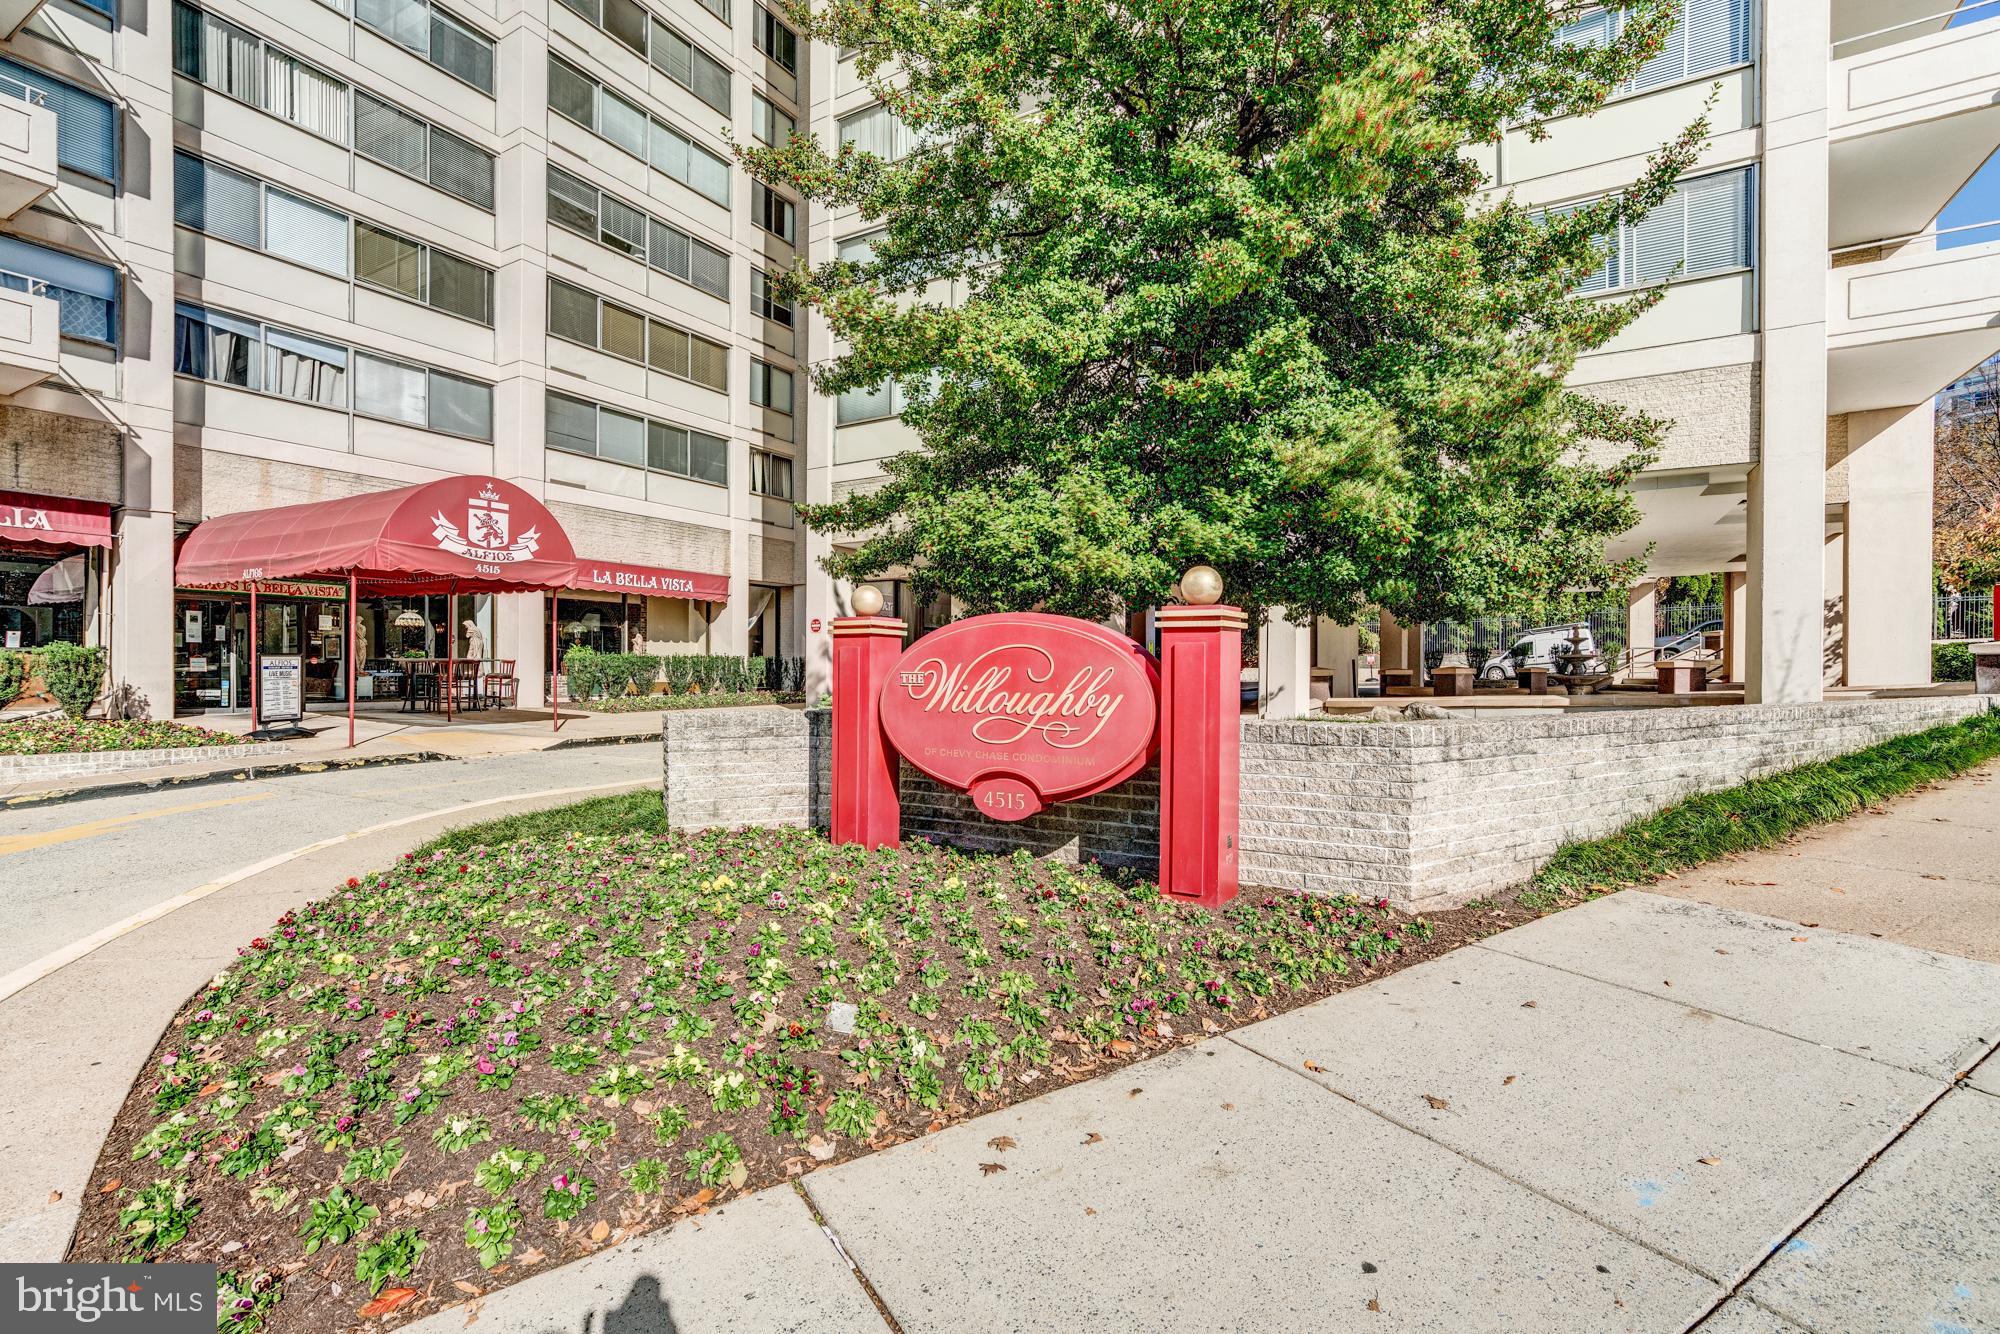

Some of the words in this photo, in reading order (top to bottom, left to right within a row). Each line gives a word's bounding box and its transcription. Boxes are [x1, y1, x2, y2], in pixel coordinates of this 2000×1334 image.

[462, 548, 515, 561] ALFIOS
[475, 563, 501, 575] 4515
[593, 569, 612, 584] LA
[615, 572, 658, 589] BELLA
[661, 576, 694, 593] VISTA
[900, 673, 925, 685] THE
[908, 643, 1124, 748] Willoughby
[924, 747, 936, 756] OF
[939, 748, 972, 758] CHEVY
[975, 751, 1009, 761] CHASE
[1012, 753, 1096, 767] CONDOMINIUM
[983, 791, 1025, 810] 4515
